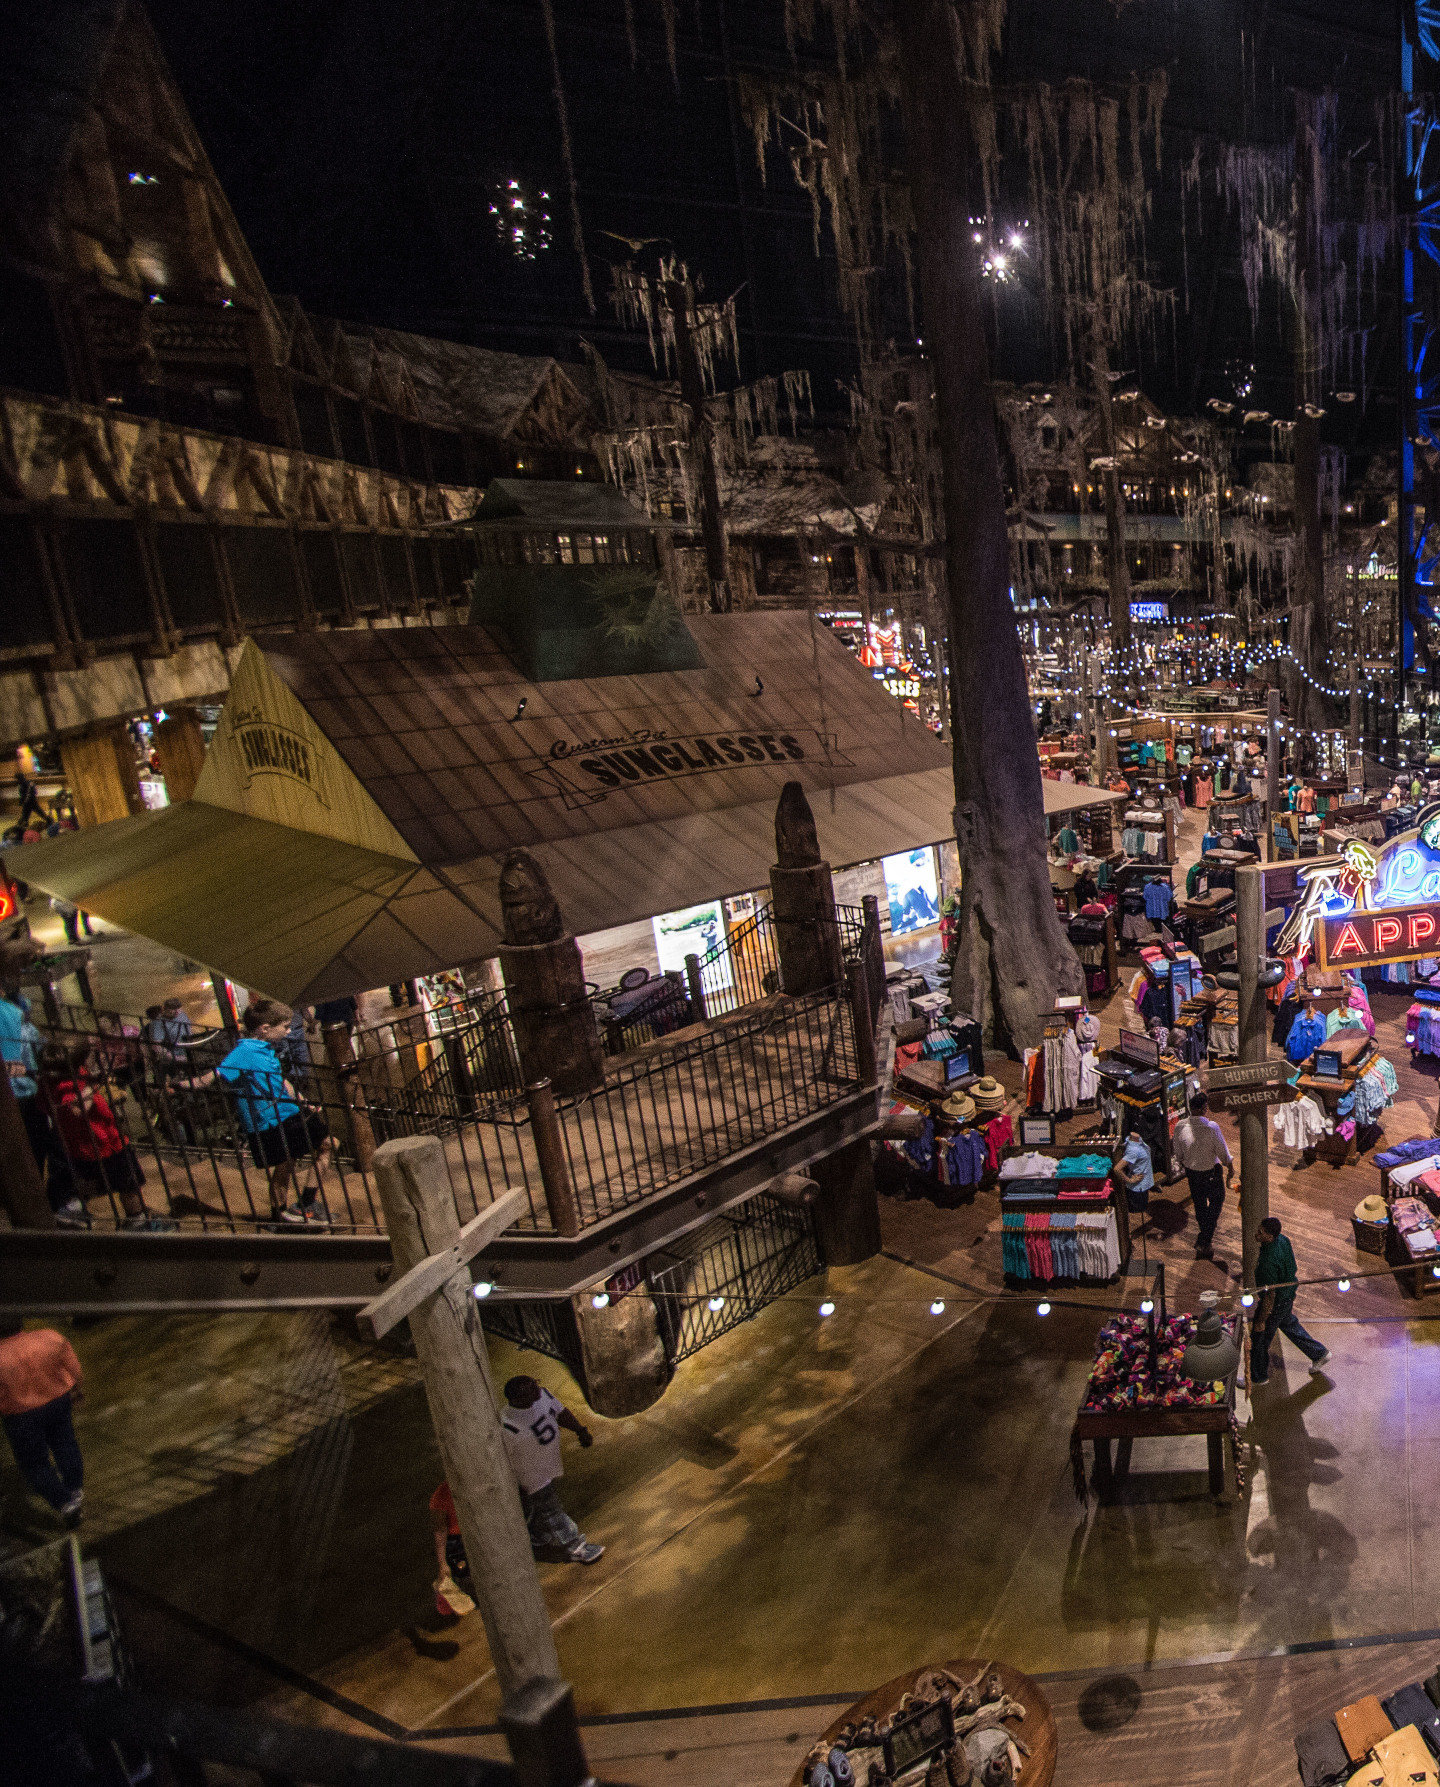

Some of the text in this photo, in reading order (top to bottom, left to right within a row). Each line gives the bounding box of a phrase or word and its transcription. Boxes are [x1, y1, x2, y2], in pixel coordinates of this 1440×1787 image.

[550, 735, 628, 760] Custom
[579, 734, 805, 787] SUNGLASSES
[1224, 1066, 1279, 1082] HUNTING
[1224, 1090, 1280, 1106] ARCHERY
[615, 1260, 641, 1294] EXIT
[530, 1407, 557, 1446] 5
